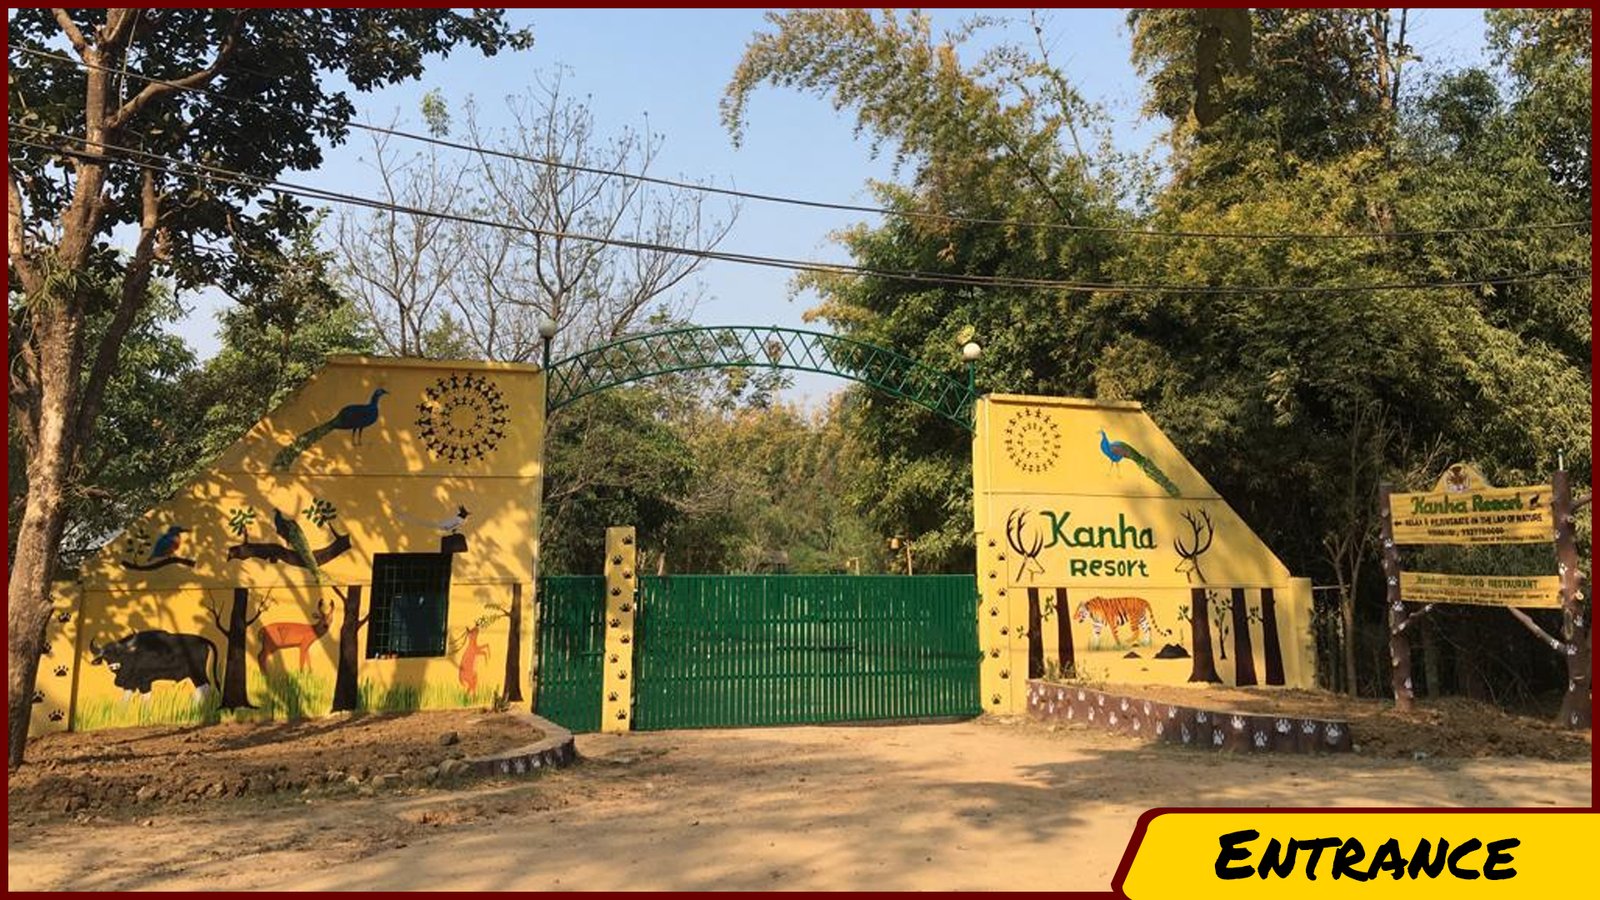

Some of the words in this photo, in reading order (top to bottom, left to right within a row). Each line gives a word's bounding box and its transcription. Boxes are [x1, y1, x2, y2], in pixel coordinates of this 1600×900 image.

[1411, 494, 1468, 515] Kanha
[1040, 510, 1157, 550] Kanha
[1069, 559, 1149, 577] Resort
[1488, 579, 1538, 589] RESTAURANT
